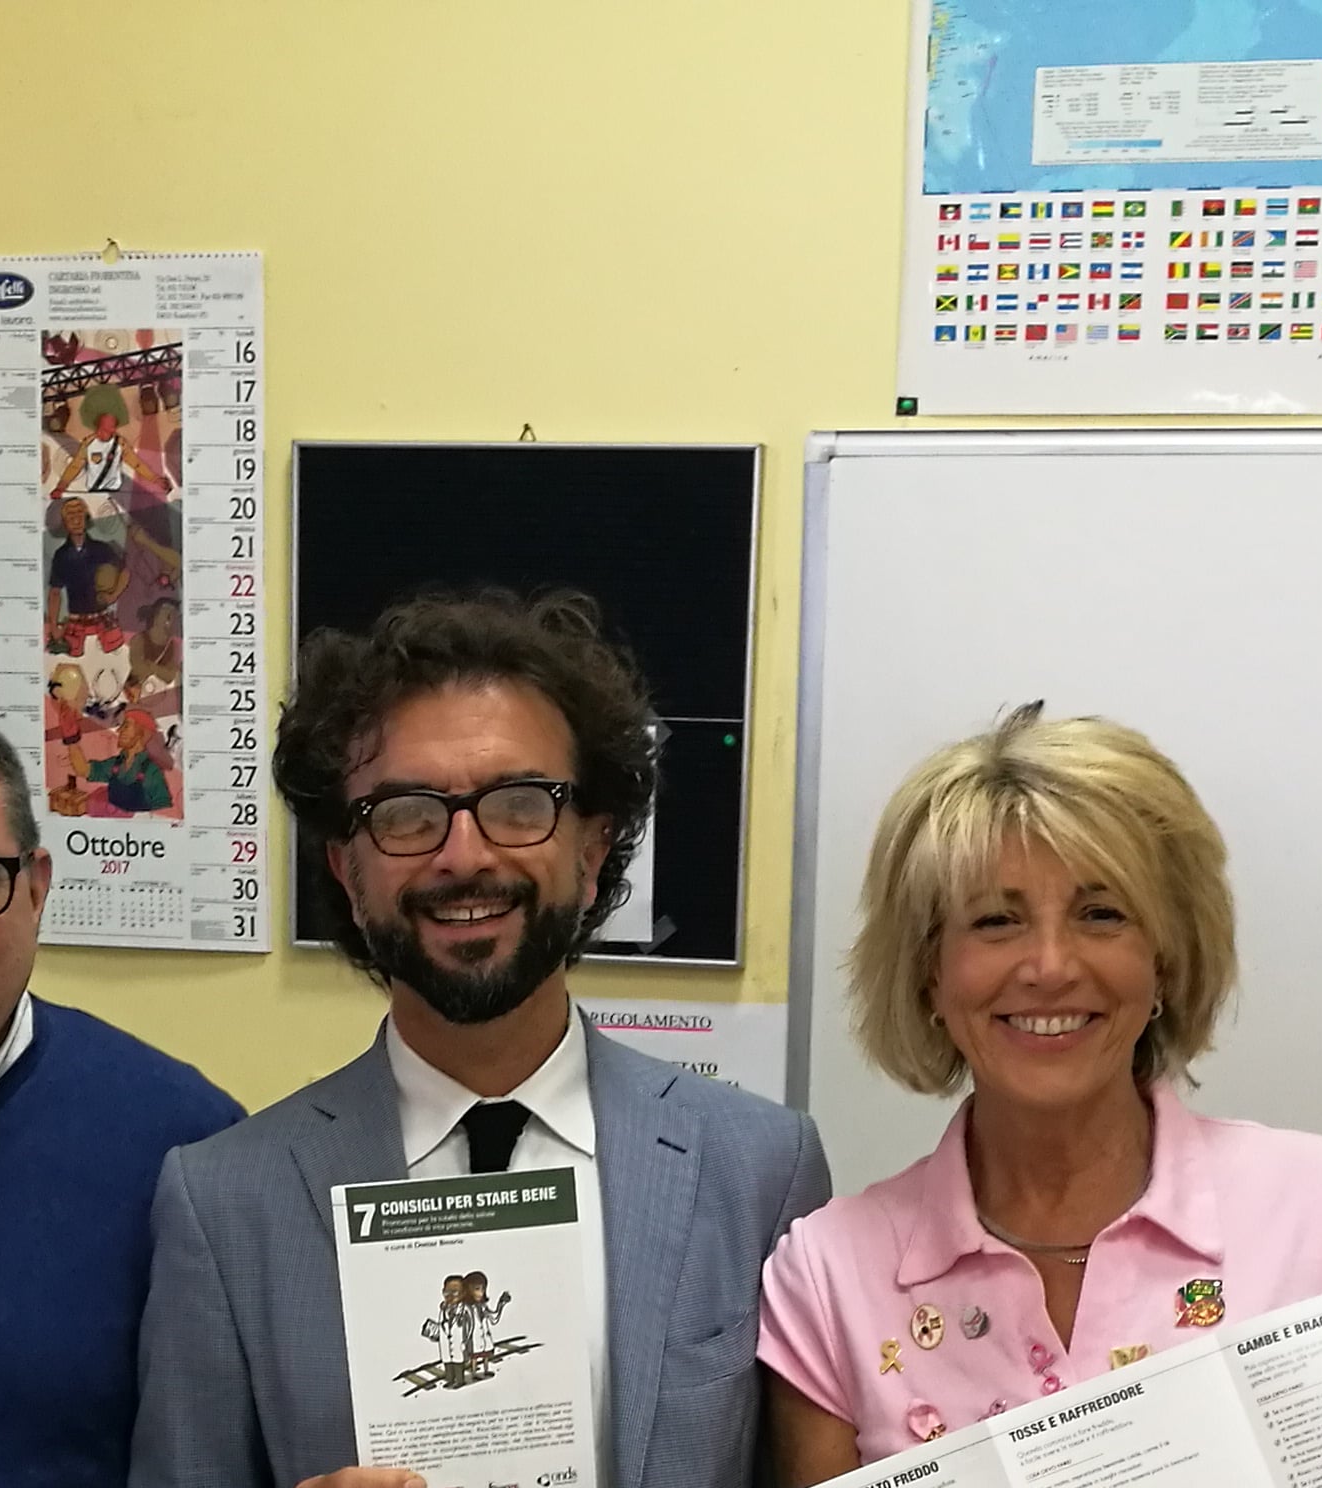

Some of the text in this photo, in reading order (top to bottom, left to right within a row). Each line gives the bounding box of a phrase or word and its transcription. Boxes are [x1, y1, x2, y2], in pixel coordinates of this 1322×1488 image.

[236, 341, 256, 363] 16
[236, 380, 256, 402] 17
[236, 419, 256, 441] 18
[236, 458, 256, 480] 19
[229, 497, 256, 519] 20
[231, 535, 253, 558] 21
[230, 574, 256, 596] 22
[230, 612, 255, 635] 23
[229, 651, 256, 674] 24
[229, 689, 256, 712] 25
[230, 727, 257, 749] 26
[230, 765, 257, 787] 27
[231, 803, 257, 825] 28
[66, 830, 165, 858] Ottobre
[231, 841, 257, 862] 29
[100, 861, 130, 874] 2017
[232, 878, 258, 900] 30
[233, 915, 255, 937] 31
[590, 1011, 712, 1028] REGOLAMENTO
[353, 1186, 556, 1237] 7 CONSIGLI PER STARE BENE
[1237, 1331, 1281, 1355] GAMBE
[1283, 1327, 1291, 1338] E
[1009, 1384, 1144, 1442] TOSSE E RAFFREDDORE
[893, 1461, 939, 1487] FREDDO
